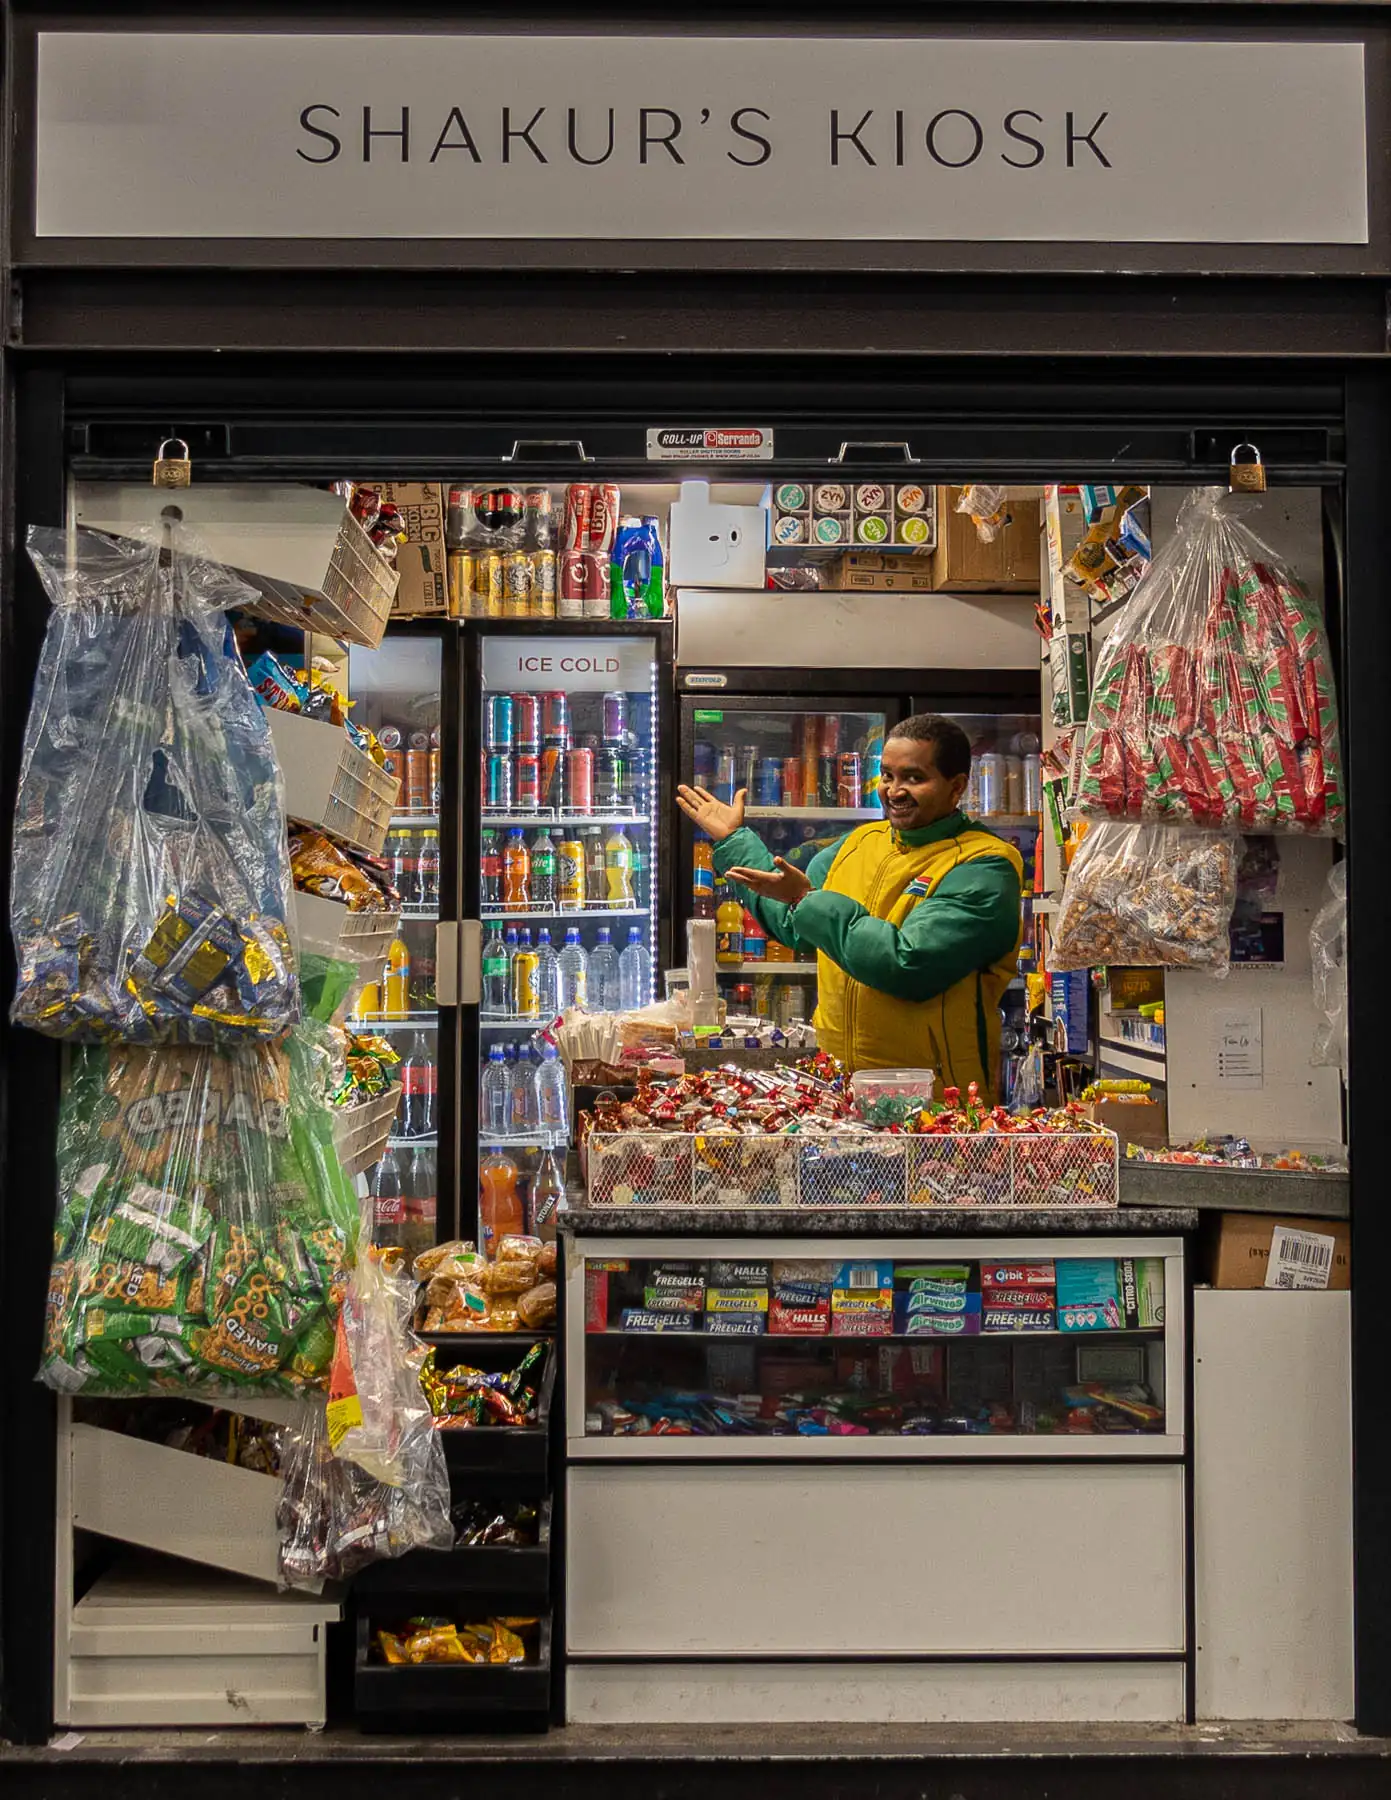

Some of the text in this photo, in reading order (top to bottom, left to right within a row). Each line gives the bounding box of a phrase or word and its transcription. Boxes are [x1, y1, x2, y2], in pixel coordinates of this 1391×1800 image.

[295, 104, 1114, 170] SHAKUR'S KIOSK
[662, 432, 761, 446] ROLL-UP Serranda
[820, 490, 844, 503] ZYN
[861, 488, 882, 507] ZYN
[901, 489, 922, 508] ZYN
[408, 505, 421, 542] KORN
[420, 503, 441, 542] BIG
[591, 500, 608, 533] Bro
[779, 519, 799, 541] ZYN
[518, 656, 620, 673] ICE COLD
[734, 1266, 768, 1276] HALLS
[996, 1269, 1023, 1283] Orbit
[655, 1276, 705, 1287] FREEGELLS
[775, 1290, 818, 1304] FREEGELL
[625, 1314, 690, 1328] FREEGELLS
[792, 1314, 827, 1324] HALLS
[985, 1312, 1051, 1325] FREEGELLS
[709, 1323, 759, 1335] FREEGELLS
[226, 1318, 279, 1356] BAKED
